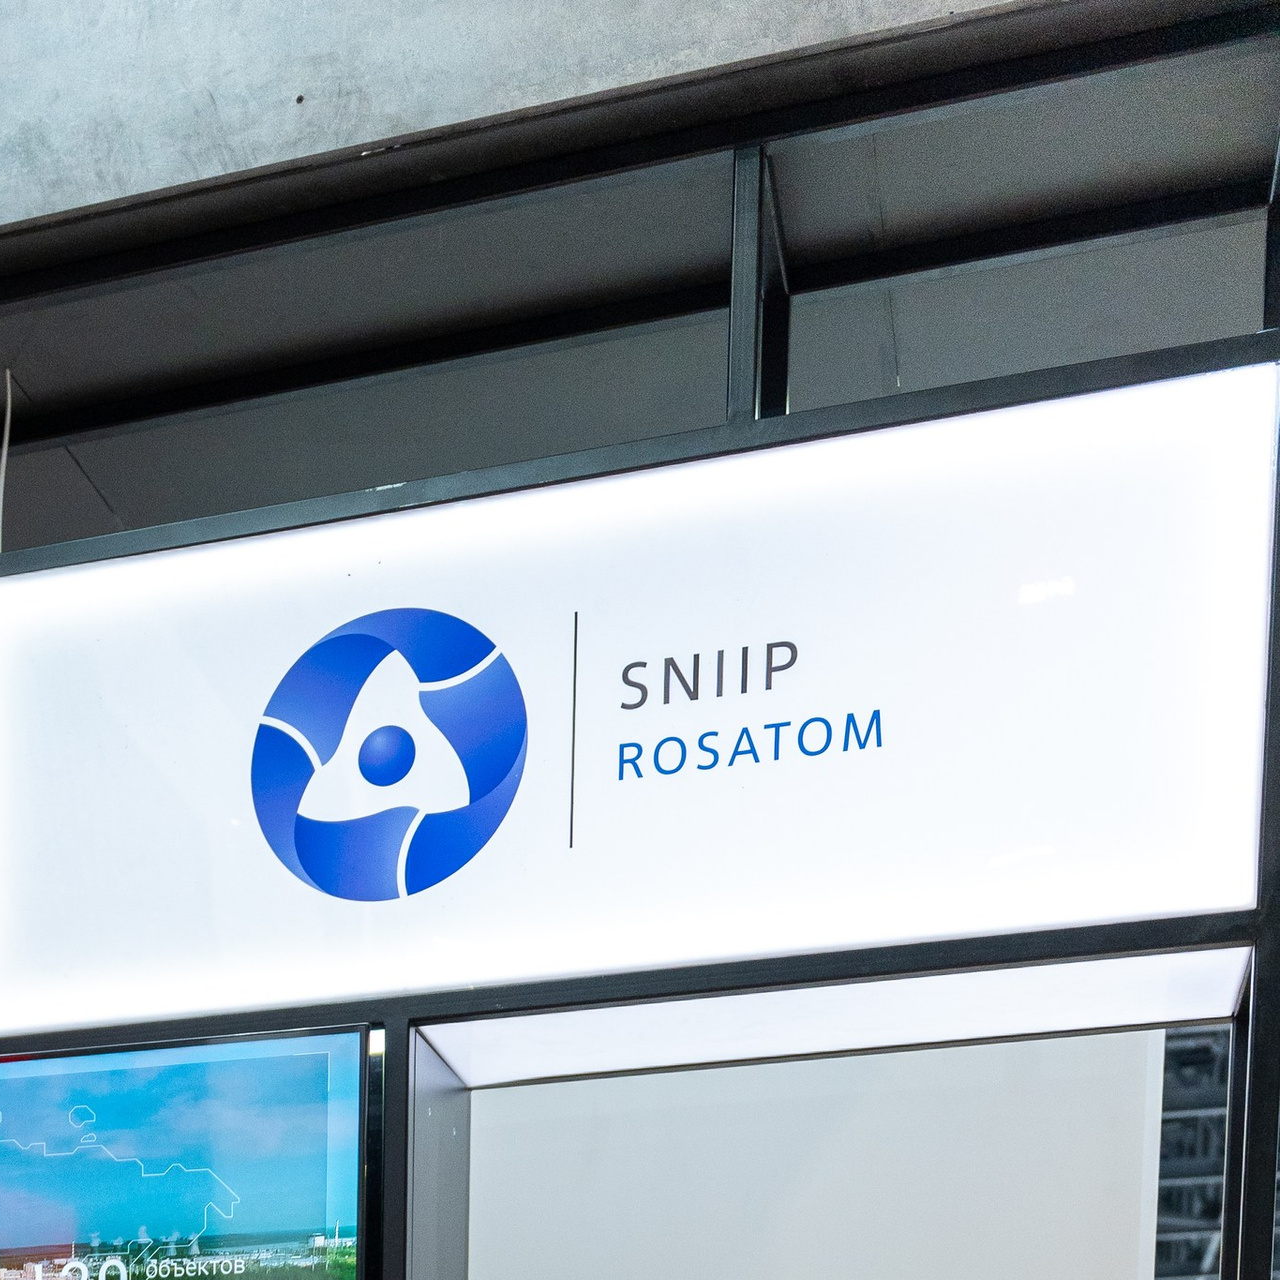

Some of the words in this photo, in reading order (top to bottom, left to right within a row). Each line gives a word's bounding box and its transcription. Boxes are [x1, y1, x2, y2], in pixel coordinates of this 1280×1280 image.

[620, 640, 798, 711] SNIIP
[618, 709, 882, 781] ROSATOM
[145, 1256, 246, 1279] объектов
